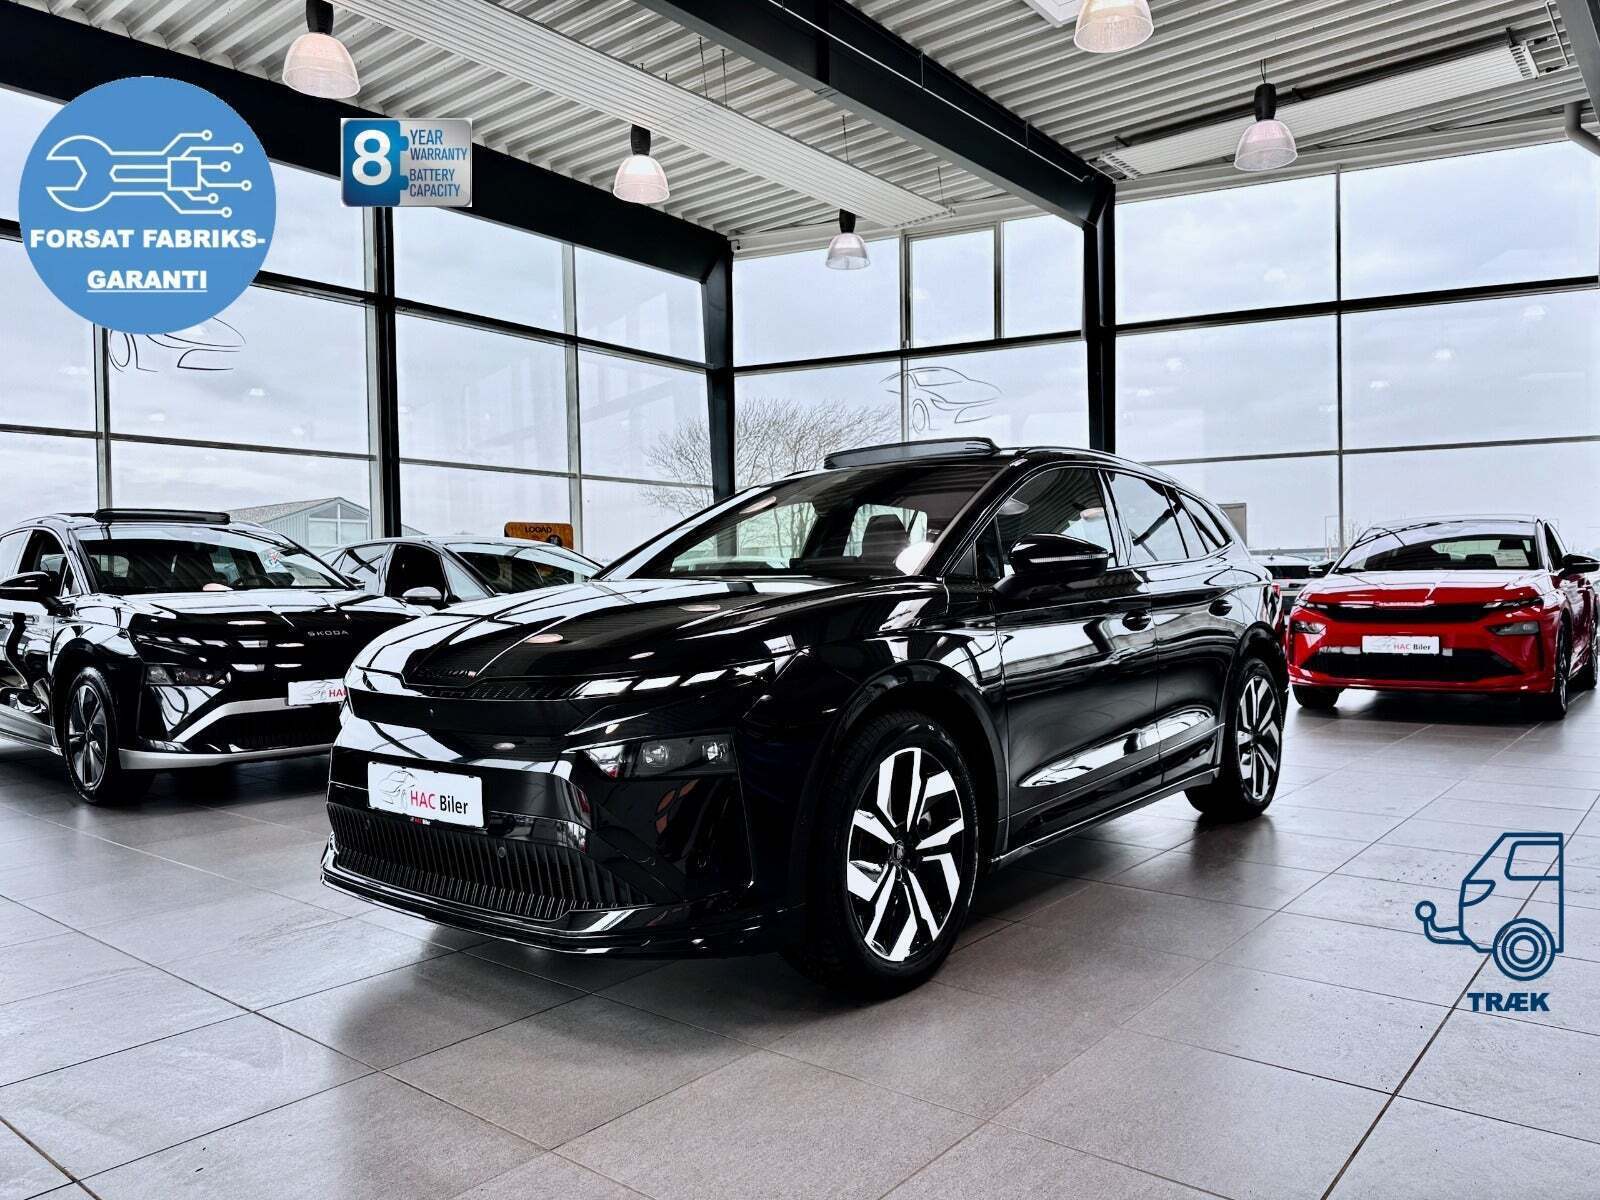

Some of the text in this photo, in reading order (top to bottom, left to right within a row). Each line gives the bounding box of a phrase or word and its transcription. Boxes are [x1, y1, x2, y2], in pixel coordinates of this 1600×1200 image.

[1413, 643, 1431, 651] Biler
[410, 789, 469, 815] HAC Biler
